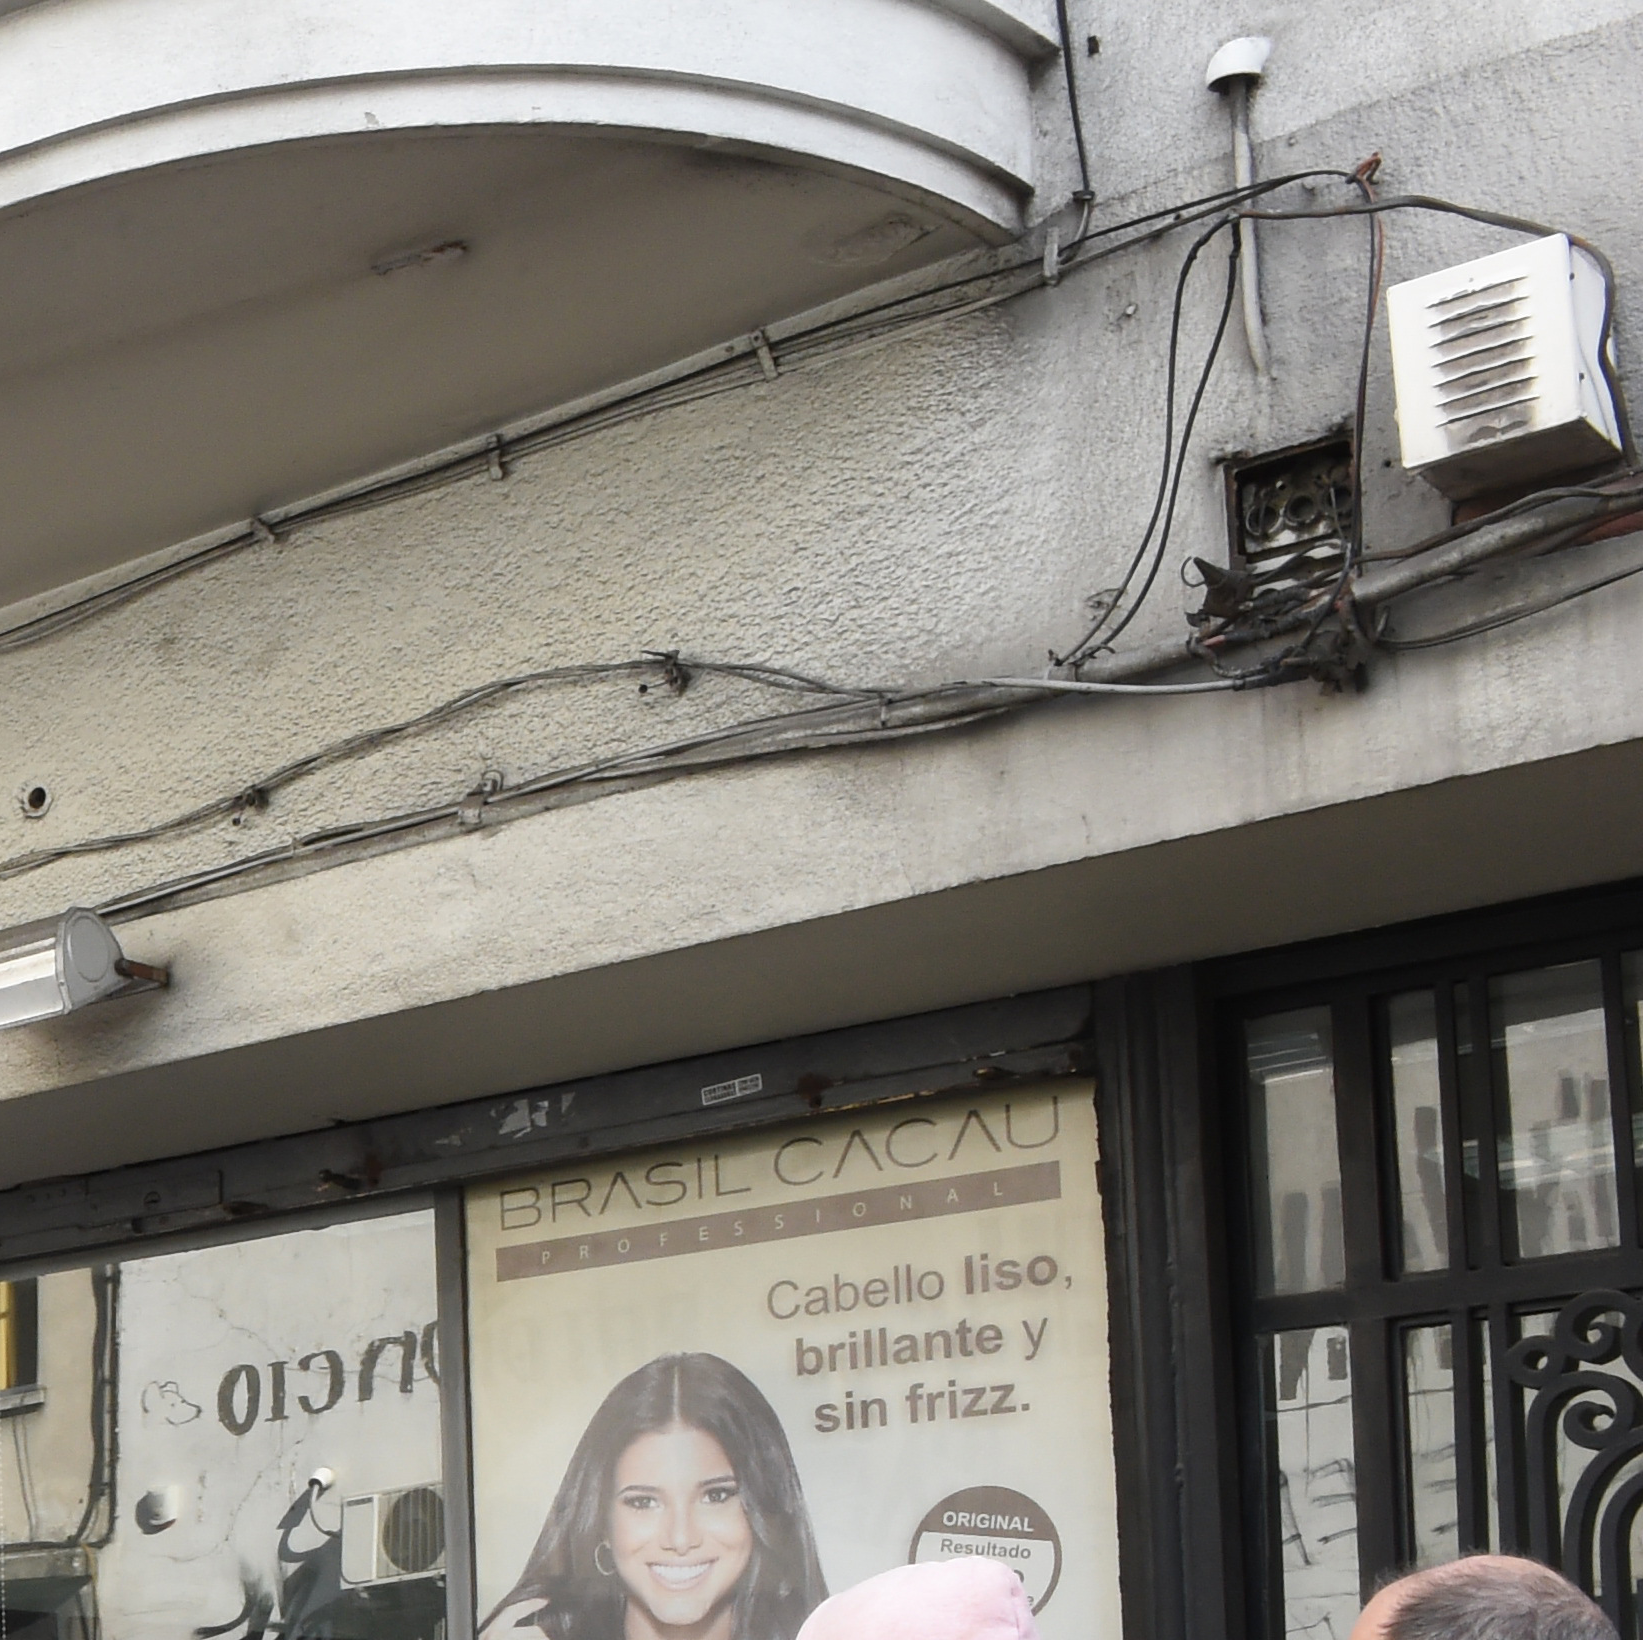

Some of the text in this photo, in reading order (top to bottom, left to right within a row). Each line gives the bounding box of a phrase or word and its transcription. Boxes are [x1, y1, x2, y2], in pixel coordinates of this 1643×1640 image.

[500, 1095, 1060, 1231] BRASIL CACAU
[541, 1181, 1003, 1265] PROFESSIONAL
[766, 1252, 1074, 1320] Cabello liso,
[795, 1316, 1048, 1377] brillante y
[814, 1381, 1032, 1433] sin frizz.
[940, 1538, 1032, 1560] Resultado
[942, 1510, 1035, 1533] ORIGINAL
